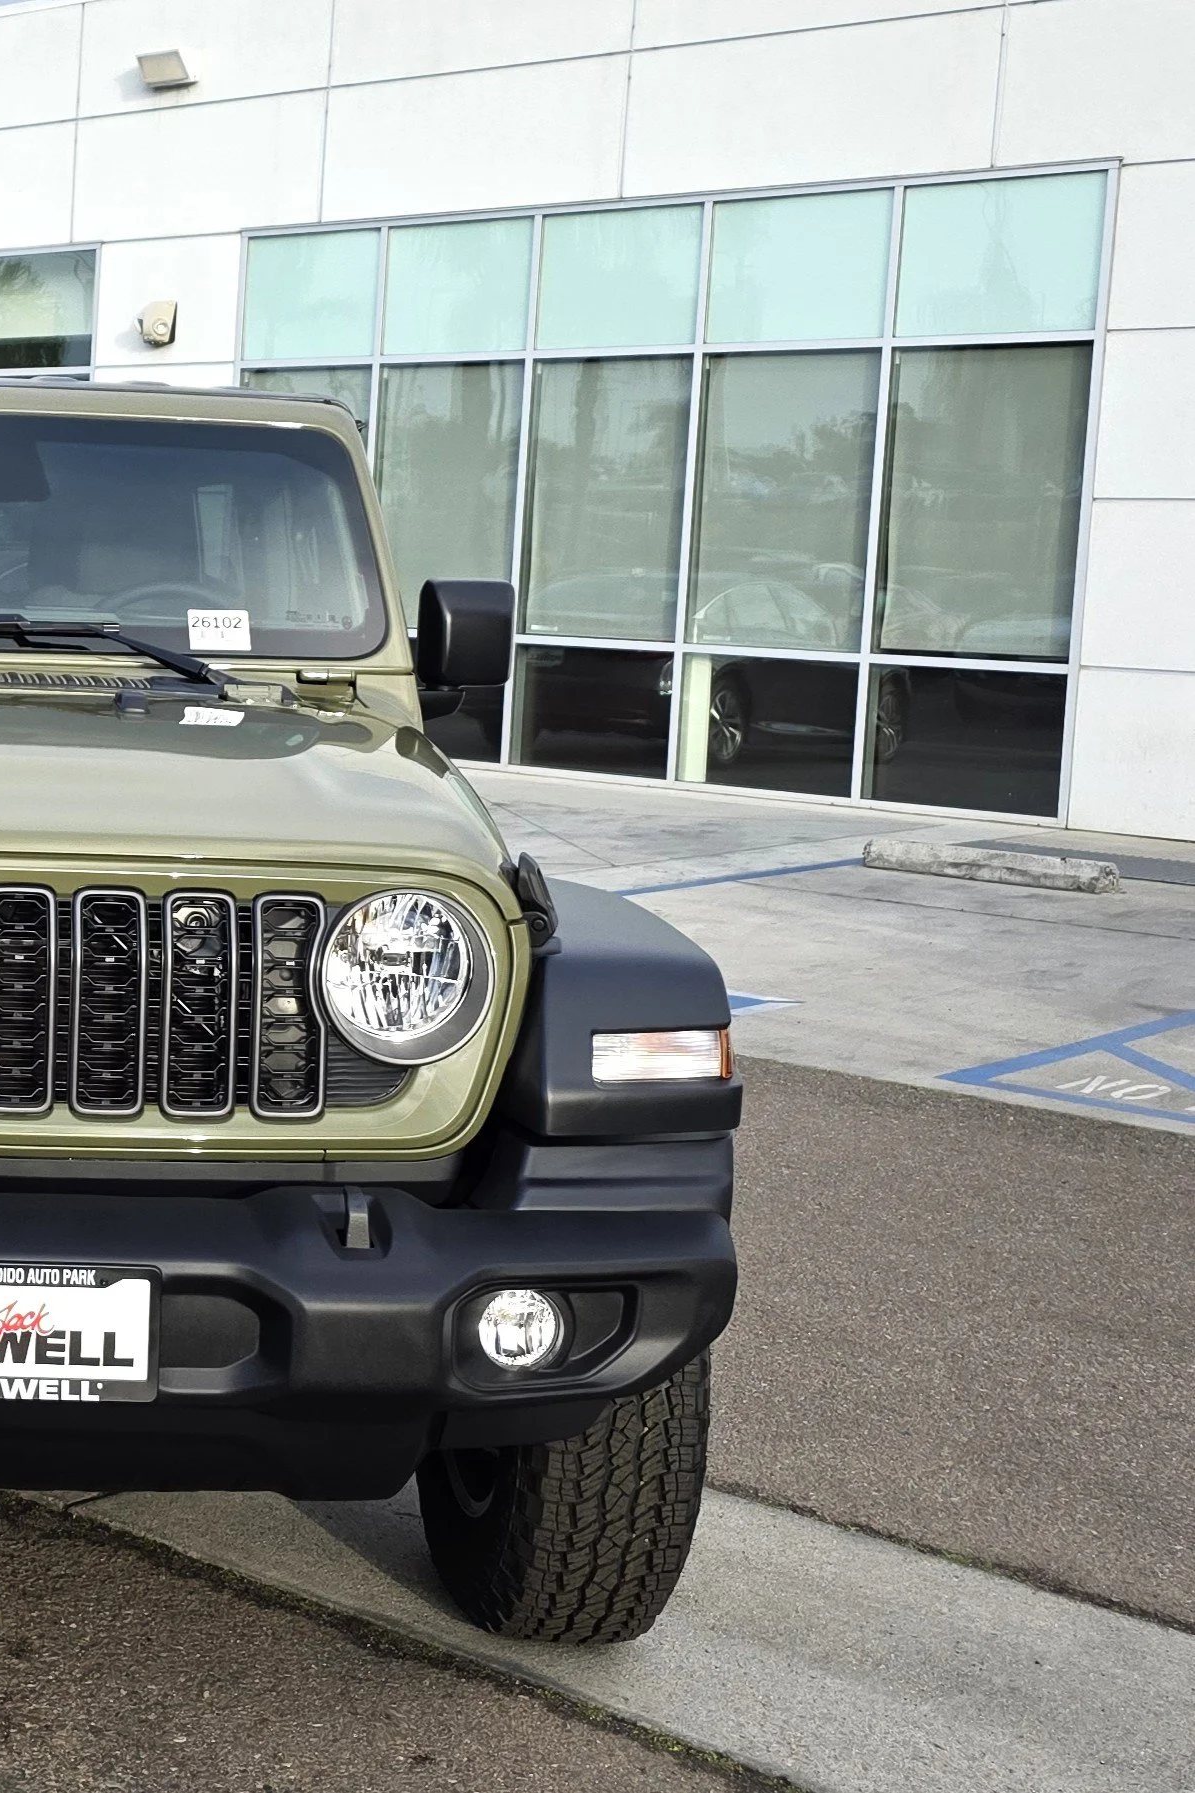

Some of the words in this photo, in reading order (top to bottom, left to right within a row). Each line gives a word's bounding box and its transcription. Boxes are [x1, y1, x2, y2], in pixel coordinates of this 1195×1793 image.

[191, 616, 242, 629] 26102
[1054, 1075, 1172, 1101] NO
[26, 1267, 60, 1285] AUTO
[62, 1268, 96, 1286] PARK
